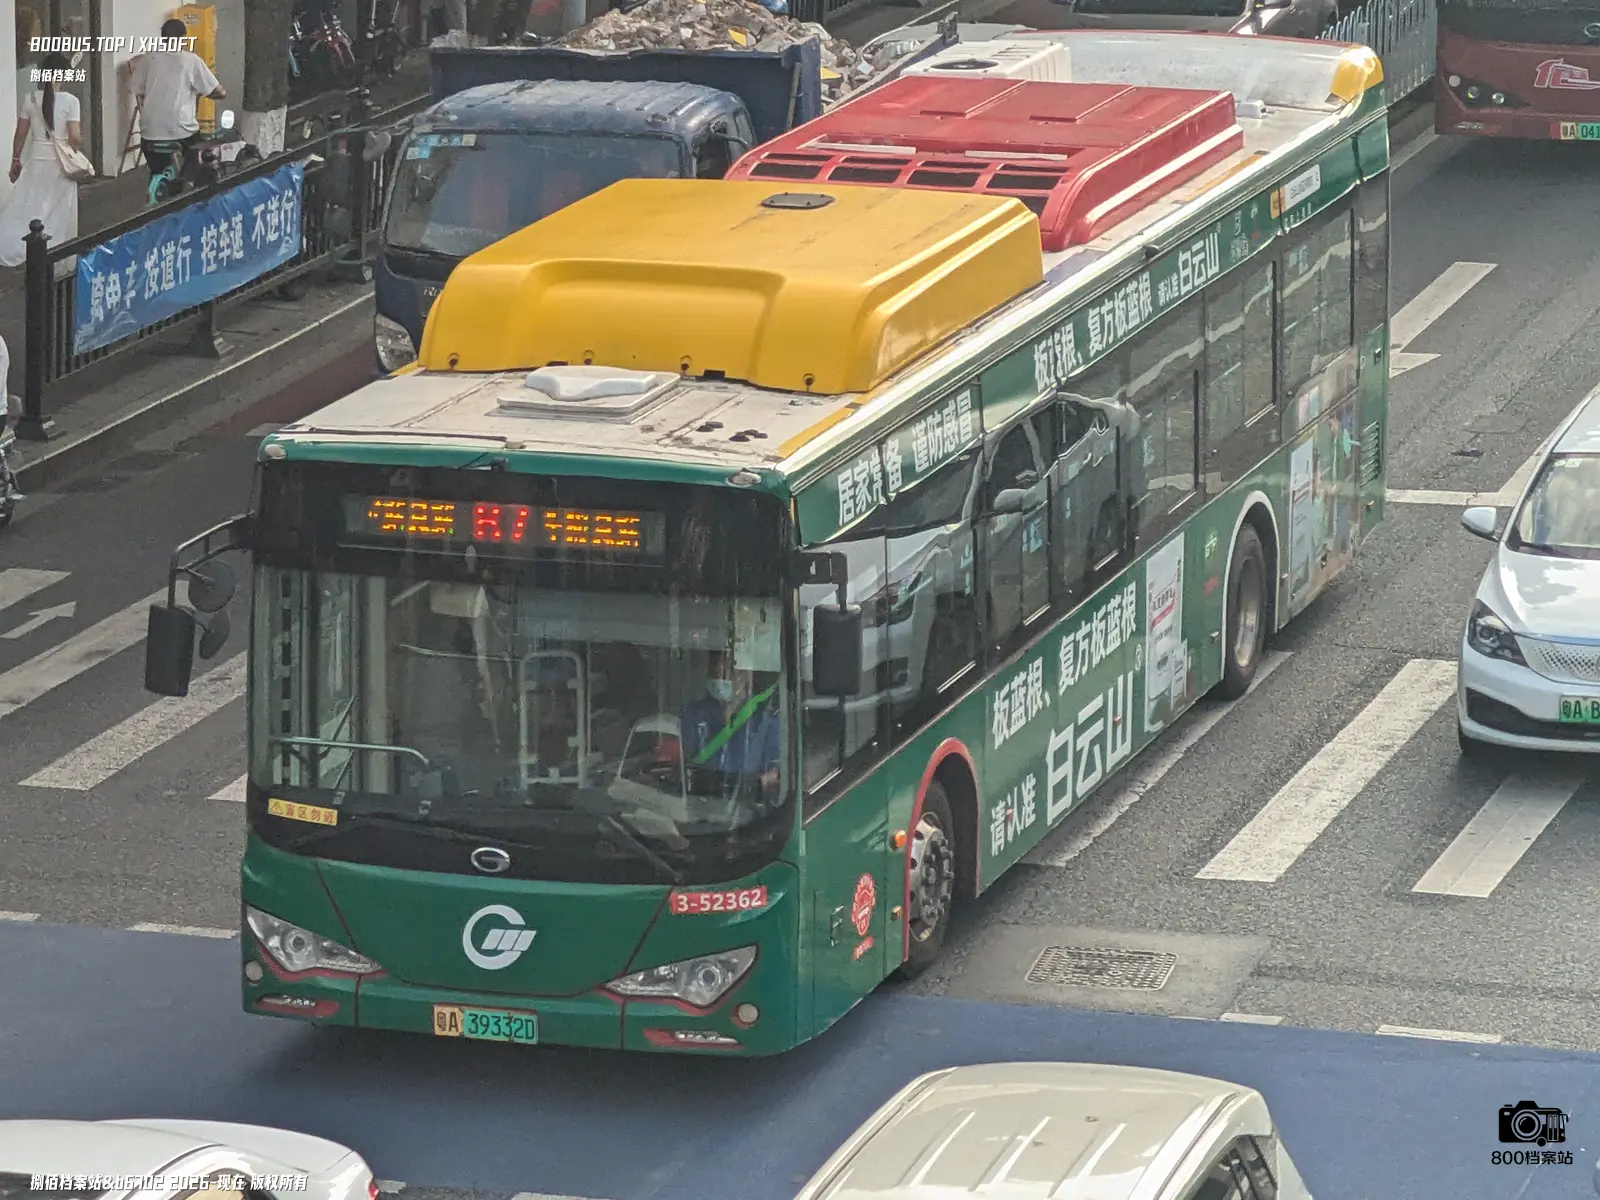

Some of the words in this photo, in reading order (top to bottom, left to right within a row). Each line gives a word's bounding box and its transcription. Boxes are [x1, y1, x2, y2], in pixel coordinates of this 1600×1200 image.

[144, 235, 192, 299] 按道行
[201, 211, 244, 275] 控车速
[252, 190, 294, 249] 不逆行
[912, 389, 972, 473] 谨防感冒
[991, 773, 1036, 857] 请认准
[1046, 670, 1133, 826] 白云山
[677, 888, 762, 912] 3-52362
